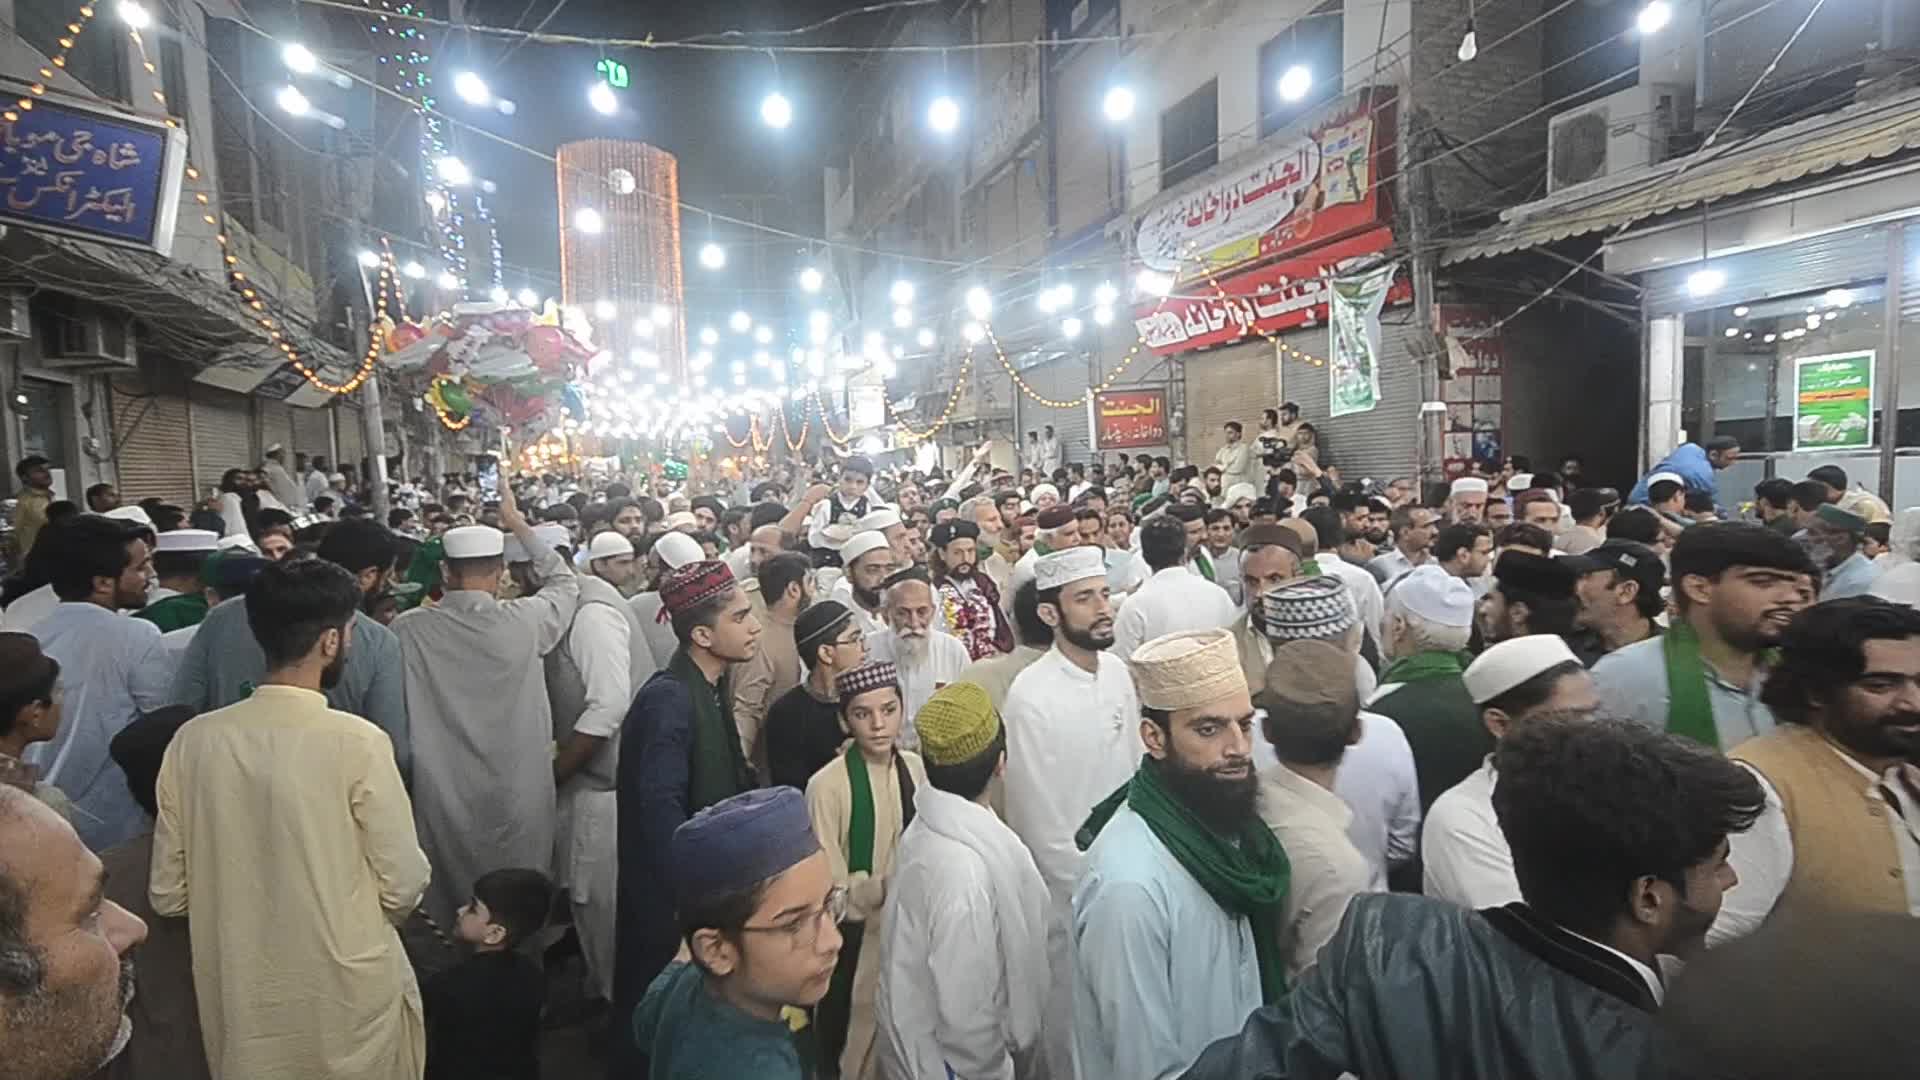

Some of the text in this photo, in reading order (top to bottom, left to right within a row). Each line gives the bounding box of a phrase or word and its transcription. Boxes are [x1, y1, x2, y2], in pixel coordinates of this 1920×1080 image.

[55, 130, 93, 164] جی
[92, 142, 141, 170] شاہ
[1243, 149, 1310, 204] الجنت
[1185, 296, 1255, 336] دواخانہ
[1101, 398, 1160, 422] الجنت
